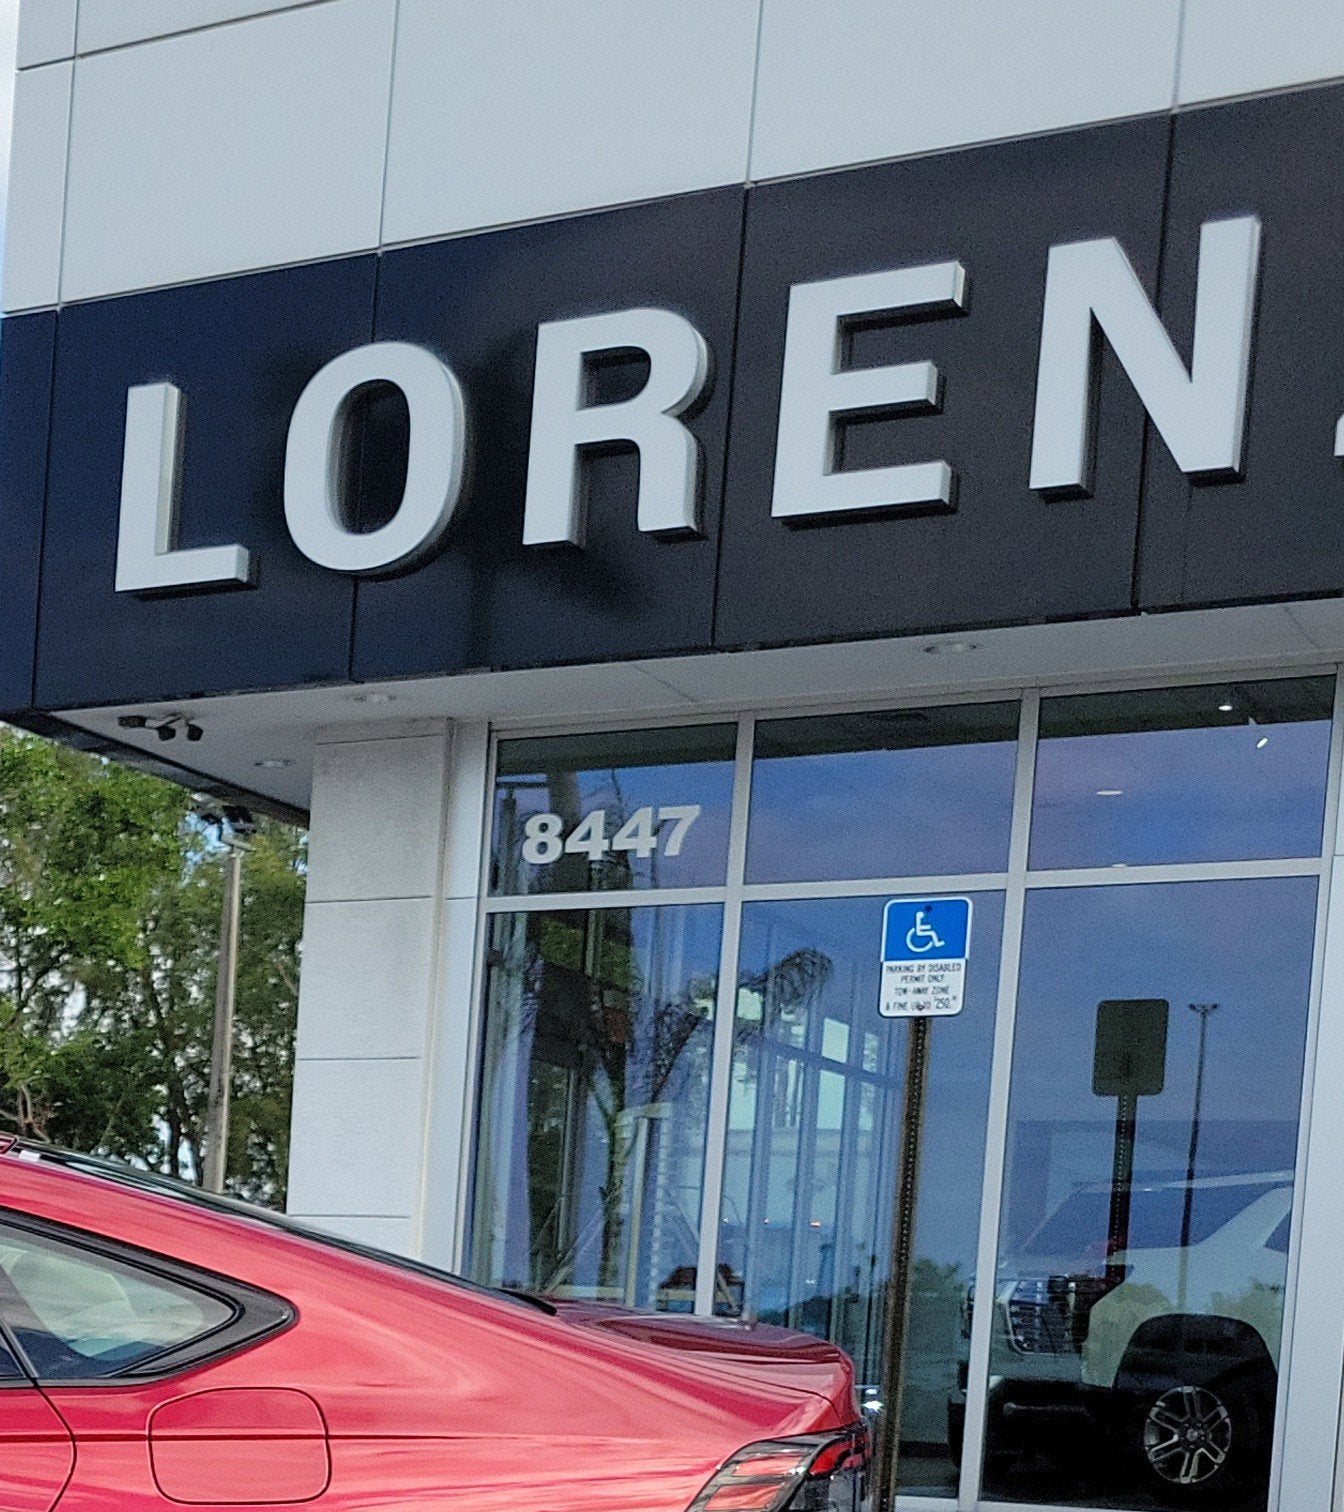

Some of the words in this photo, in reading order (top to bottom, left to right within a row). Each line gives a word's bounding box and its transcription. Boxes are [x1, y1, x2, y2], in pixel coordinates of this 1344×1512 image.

[116, 214, 1344, 592] LOREN
[522, 804, 701, 865] 8447
[886, 964, 914, 974] PARKING
[917, 963, 926, 973] BY
[928, 963, 961, 973] DISABLED
